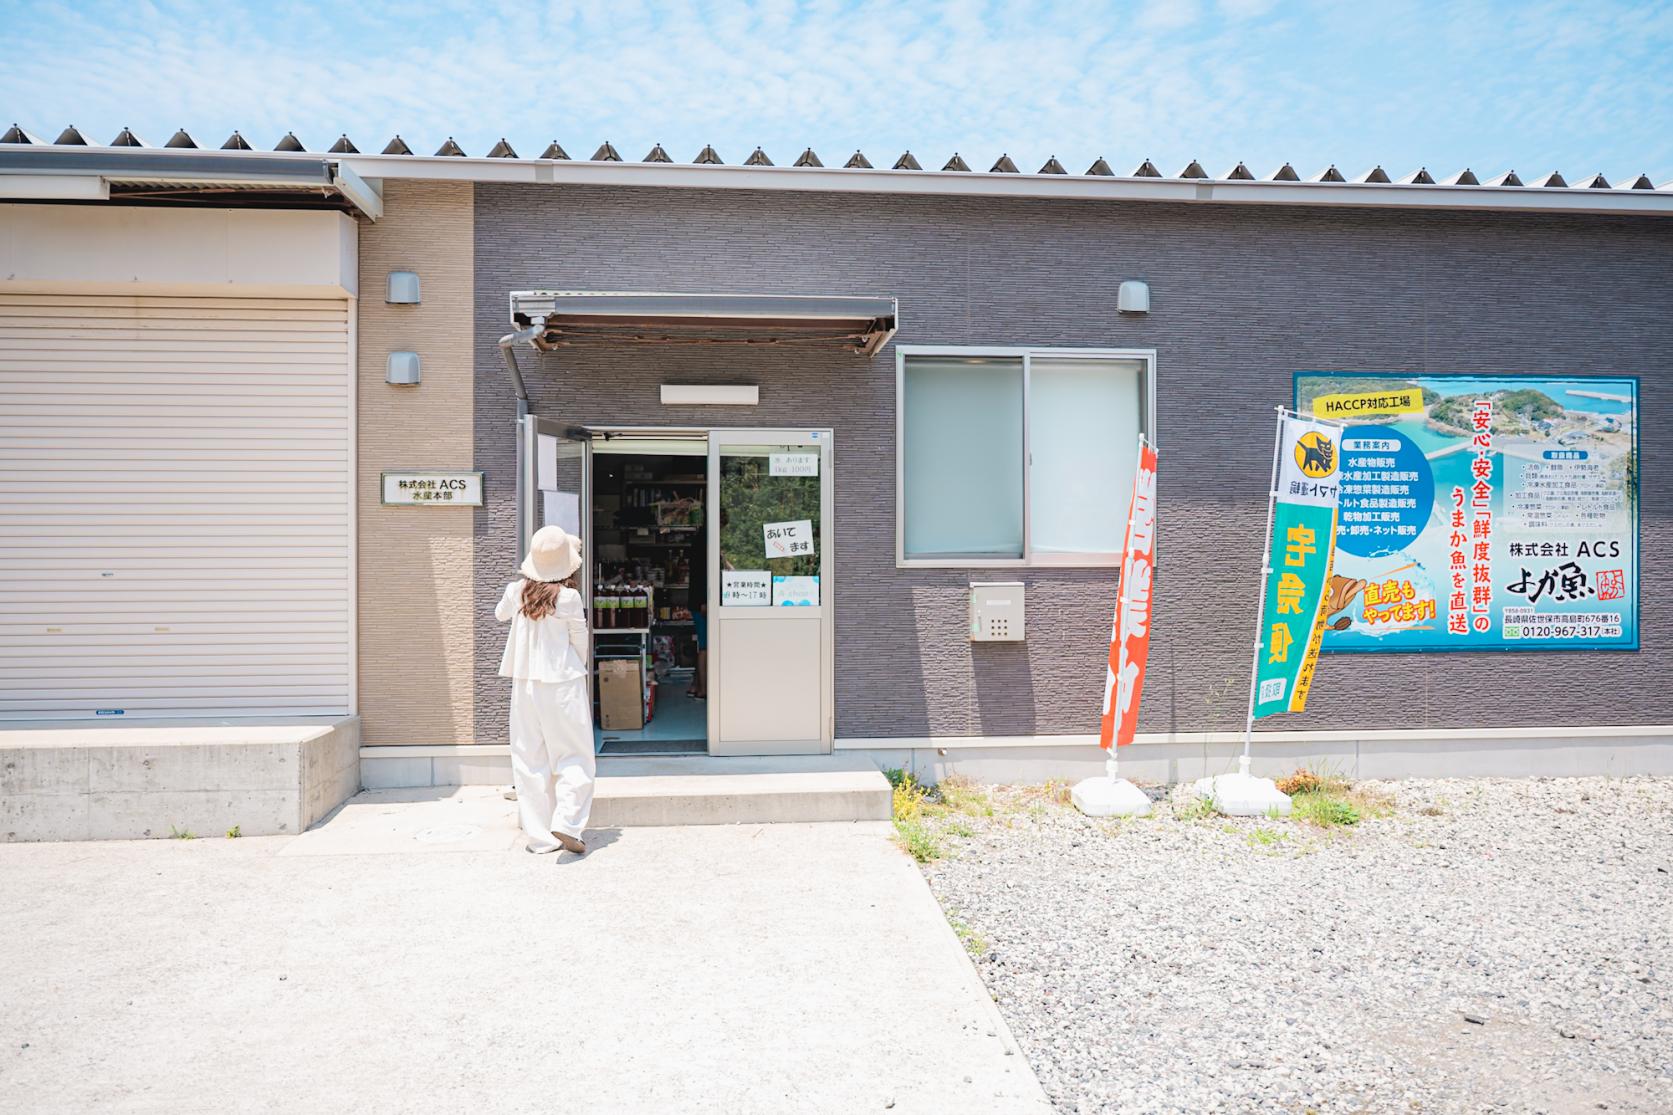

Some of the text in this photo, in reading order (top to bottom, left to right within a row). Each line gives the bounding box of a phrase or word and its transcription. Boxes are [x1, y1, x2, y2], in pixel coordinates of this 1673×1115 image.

[1326, 396, 1411, 412] HACCP対応工場
[1353, 441, 1390, 450] 業務案内
[1348, 458, 1396, 468] 水産物販売
[399, 479, 466, 490] 株式会社 ACS
[413, 491, 453, 501] 水産本部
[1343, 512, 1400, 522] 乾物加工販売
[766, 526, 797, 540] あいて
[789, 541, 810, 553] ます
[1509, 541, 1620, 558] 株式会社 ACS
[1449, 487, 1468, 633] うまか魚を直送
[1506, 562, 1595, 603] よか魚
[1364, 579, 1416, 607] 直売も
[1363, 599, 1436, 625] やってます!
[1504, 614, 1620, 624] 長崎県佐世保市高島町676番16
[1522, 626, 1601, 637] 0120-967-317
